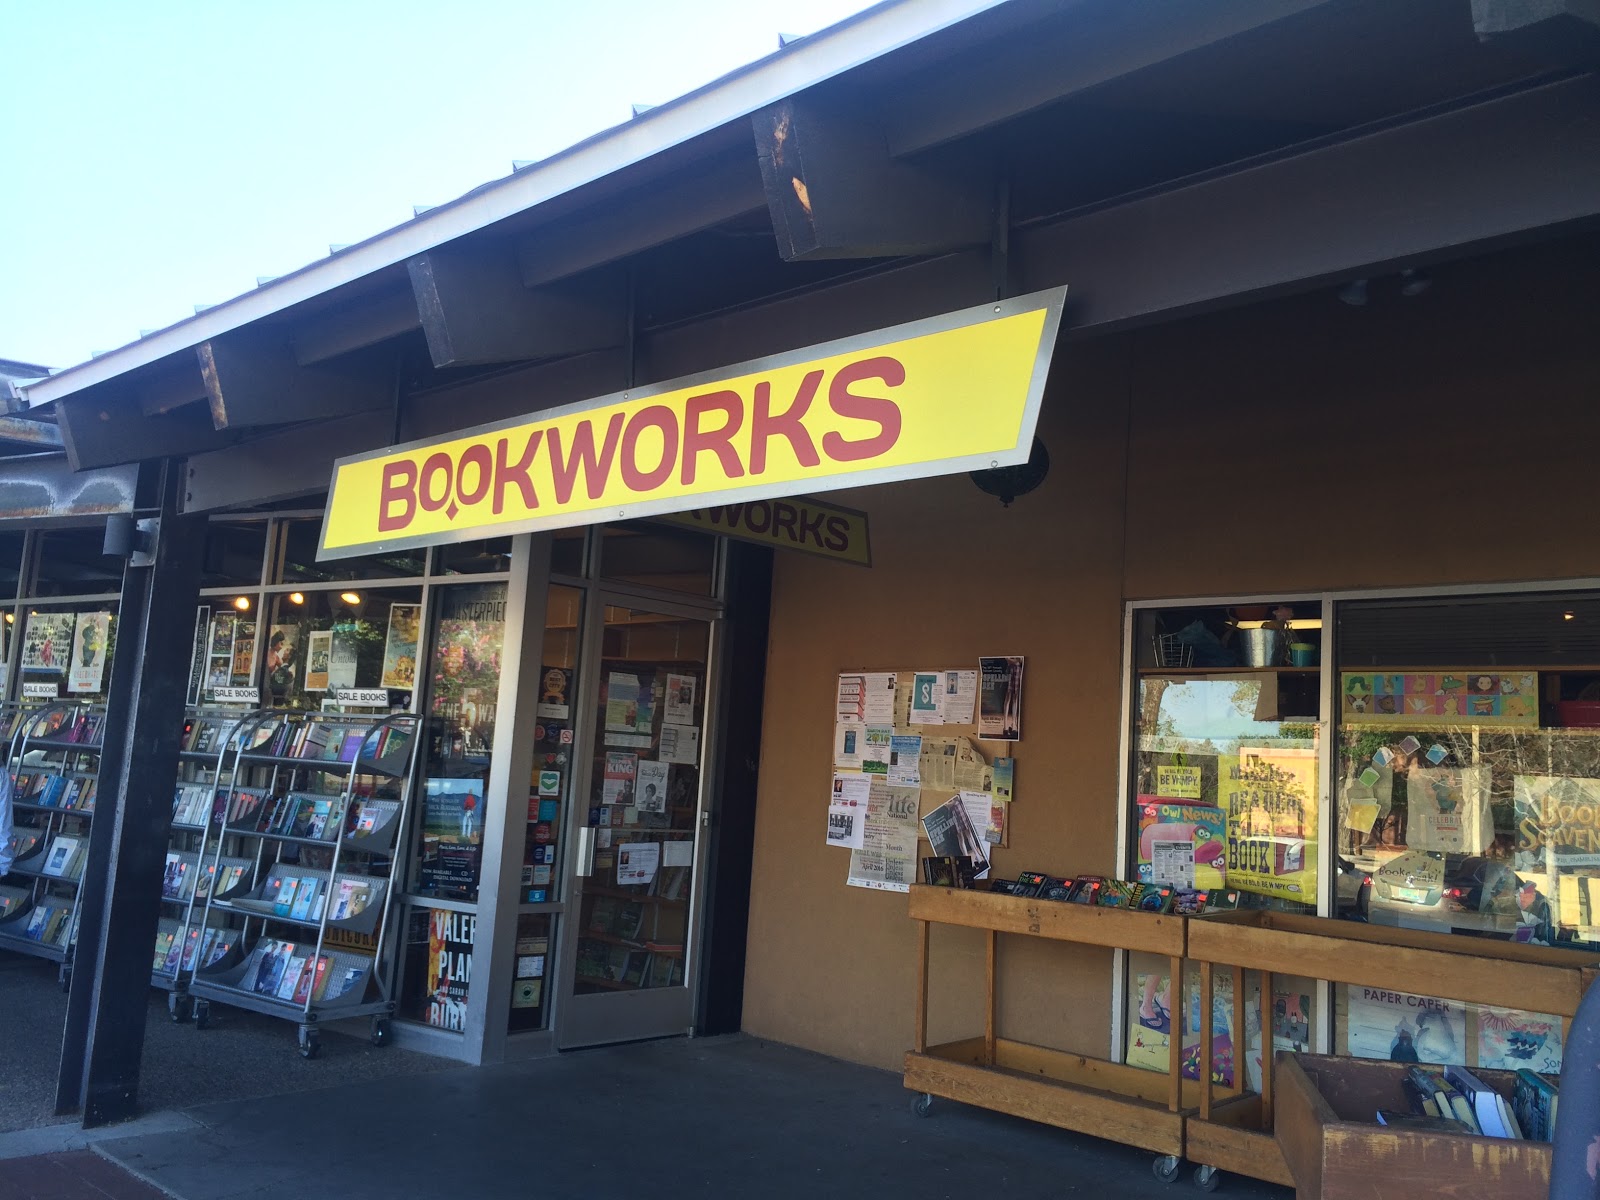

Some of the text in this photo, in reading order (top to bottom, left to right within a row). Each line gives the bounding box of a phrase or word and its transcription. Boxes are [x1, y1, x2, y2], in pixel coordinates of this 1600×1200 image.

[378, 357, 906, 532] BOOKWORKS
[691, 501, 850, 552] WORKS
[23, 685, 57, 694] SALE BOOKS
[214, 689, 258, 698] SALE BOOKS
[338, 692, 387, 701] SALE BOOKS
[607, 763, 633, 774] KING
[1160, 775, 1170, 785] BE
[888, 794, 916, 815] life
[887, 812, 908, 820] National
[1161, 805, 1223, 826] Owl News!
[1229, 837, 1270, 874] BOOK
[1261, 881, 1269, 889] BE
[1364, 988, 1451, 1013] PAPER CAPER
